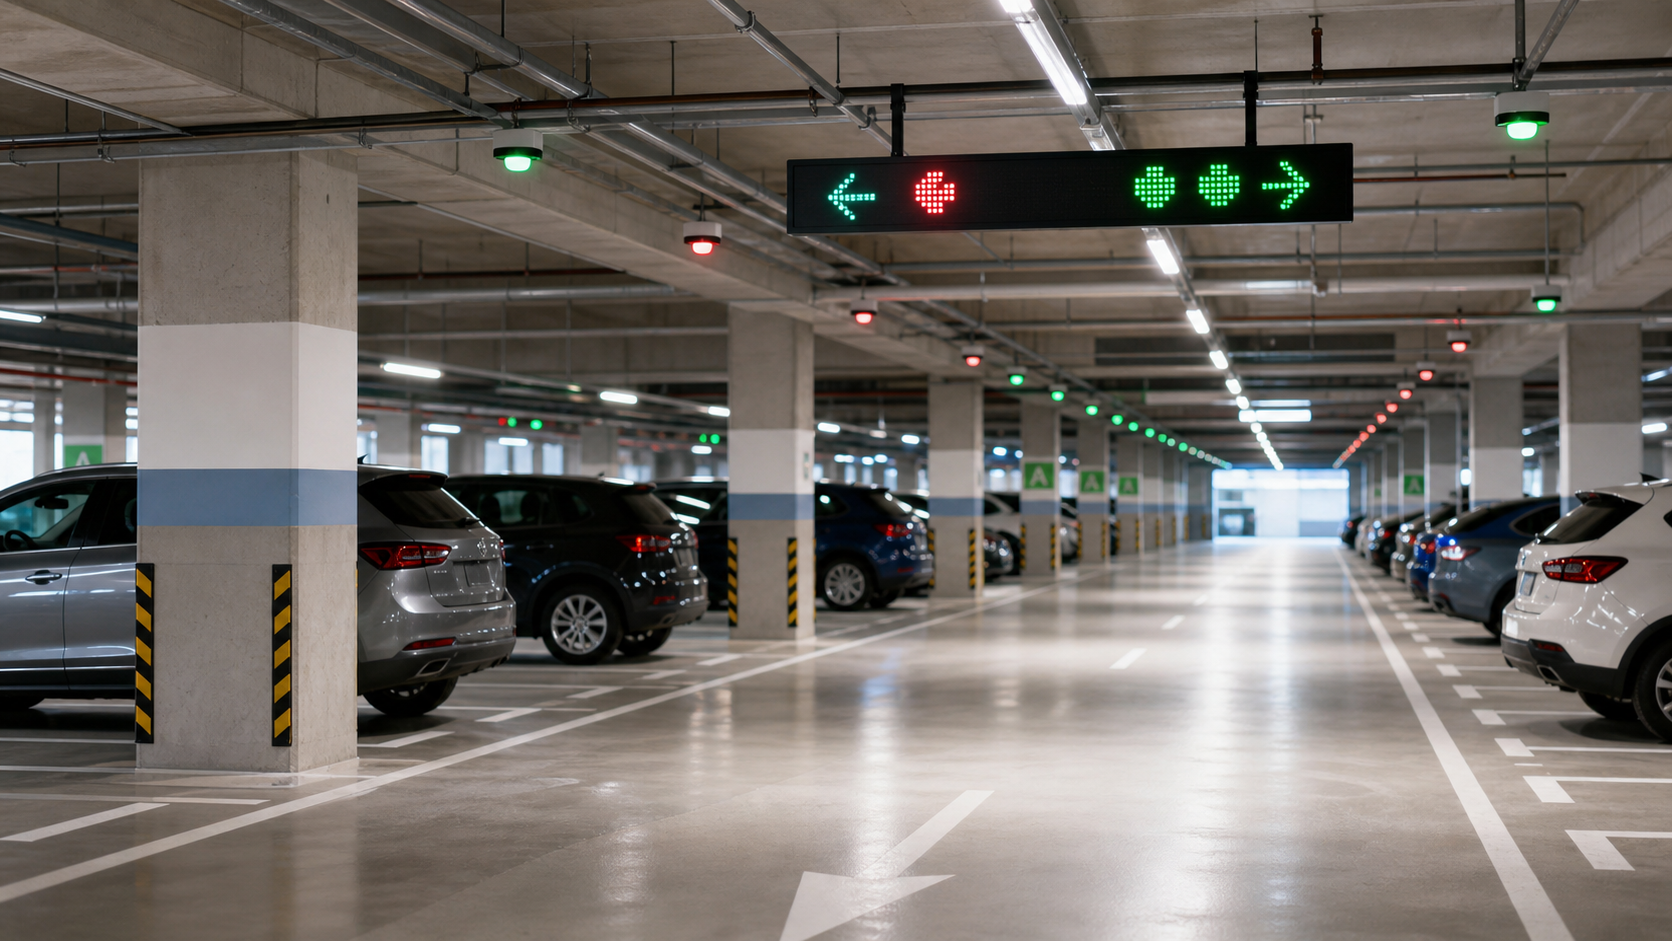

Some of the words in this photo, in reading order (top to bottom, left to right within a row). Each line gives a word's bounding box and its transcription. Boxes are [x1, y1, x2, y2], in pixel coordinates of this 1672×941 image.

[1029, 466, 1049, 486] A
[1084, 474, 1100, 490] A
[1123, 479, 1134, 492] A
[1408, 477, 1421, 492] A
